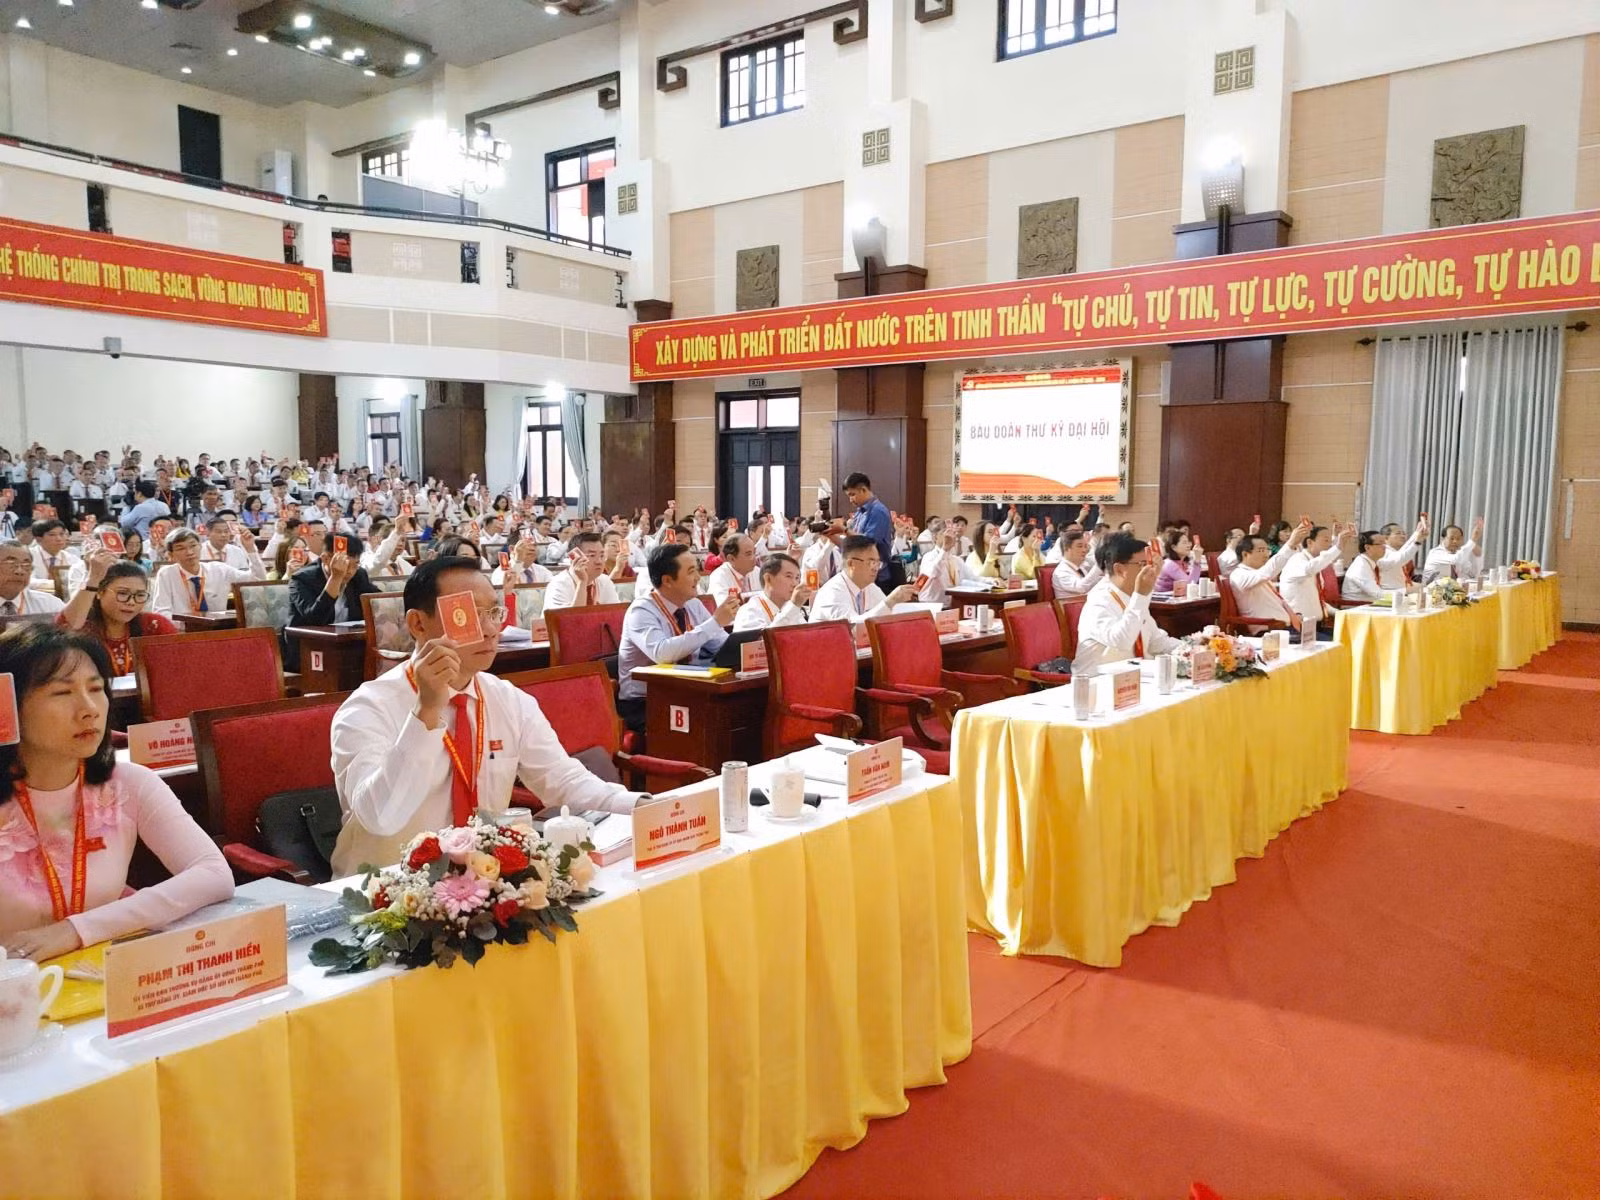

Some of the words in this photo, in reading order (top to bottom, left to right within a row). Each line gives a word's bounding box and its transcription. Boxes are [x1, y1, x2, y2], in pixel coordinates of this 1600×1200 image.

[16, 243, 59, 281] THỐNG
[62, 254, 99, 287] CHÍNH
[102, 263, 121, 295] TRỊ
[123, 266, 161, 294] TRONG
[163, 272, 195, 303] SẠCH,
[197, 273, 226, 303] VỮNG
[228, 281, 258, 311] MẠNH
[259, 283, 285, 312] TOÀN
[286, 287, 309, 318] DIỆN
[656, 335, 679, 365] XÂY
[682, 334, 717, 368] DỰNG
[720, 328, 737, 360] VÀ
[740, 324, 775, 358] PHÁT
[779, 314, 820, 354] TRIỂN
[824, 312, 853, 351] ĐẤT
[856, 312, 900, 348] NƯỚC
[904, 307, 947, 344] TRÊN
[952, 308, 992, 341] TINH
[997, 293, 1045, 336] THẦN
[1092, 282, 1138, 329] CHỦ,
[1145, 285, 1174, 330] TỰ
[1178, 285, 1219, 322] TIN,
[1227, 276, 1259, 322] TỰ
[1262, 272, 1315, 319] LỰC,
[1324, 265, 1358, 313] TỰ
[1363, 253, 1463, 304] CƯỜNG,
[1474, 248, 1513, 300] TỰ
[1518, 240, 1581, 289] HÀO
[1026, 423, 1046, 438] THƯ
[966, 607, 972, 617] C
[676, 710, 683, 727] B
[649, 825, 663, 840] NGÔ
[665, 821, 687, 836] THÀNH
[138, 967, 173, 987] PHẠM
[176, 962, 194, 976] THỊ
[197, 951, 232, 971] THANH
